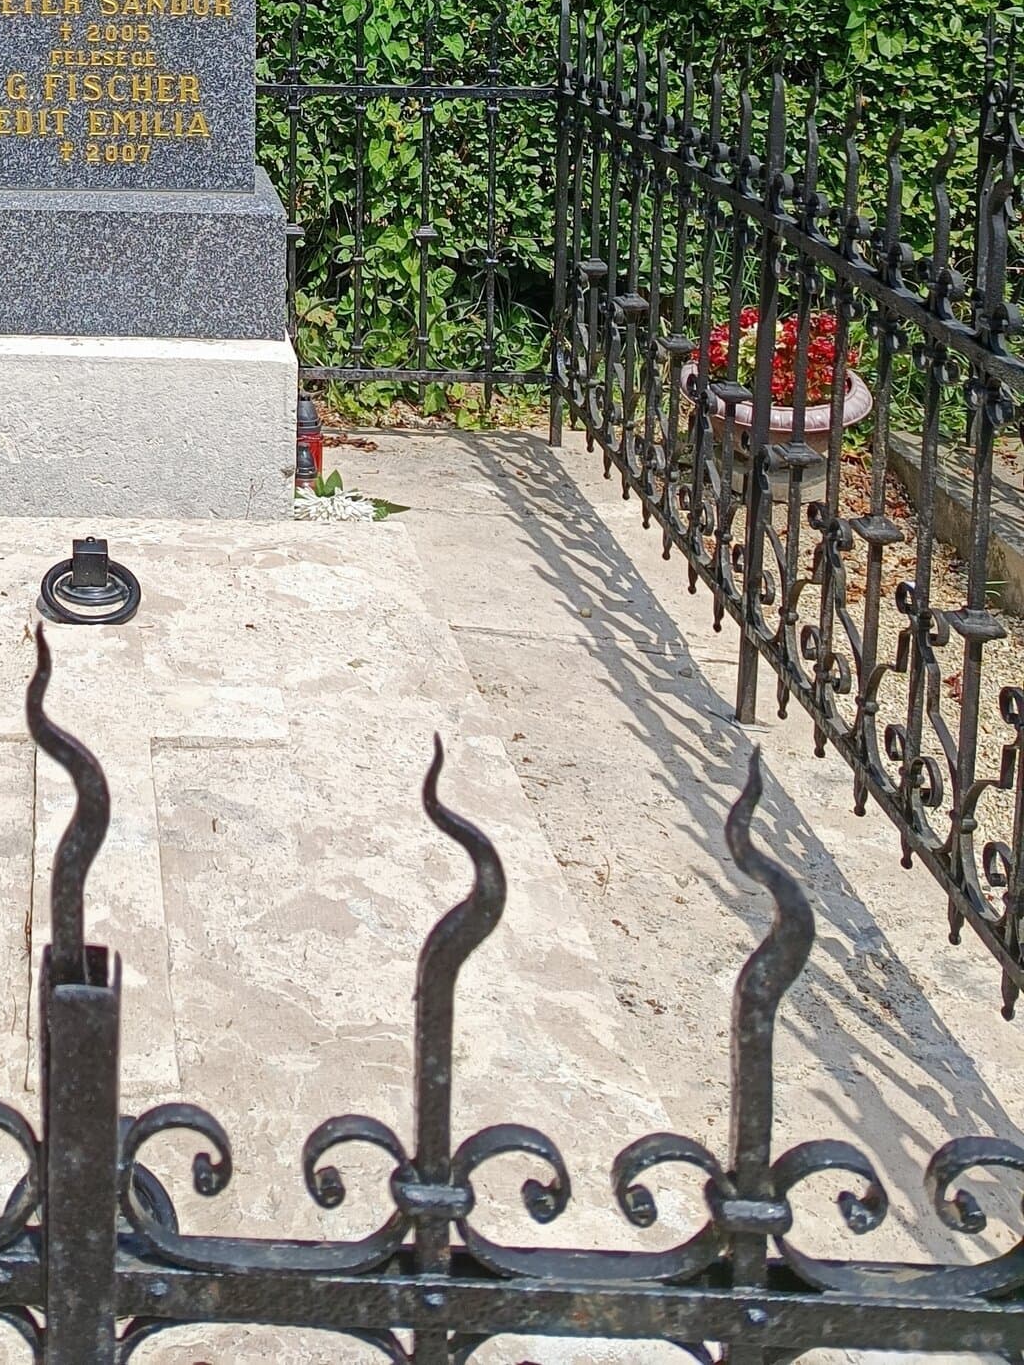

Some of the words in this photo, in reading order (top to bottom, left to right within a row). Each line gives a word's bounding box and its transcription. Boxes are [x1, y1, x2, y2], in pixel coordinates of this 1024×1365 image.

[87, 24, 151, 42] 2005
[44, 73, 200, 103] FISCHER
[89, 110, 209, 138] EMILIA
[87, 144, 151, 162] 2007
